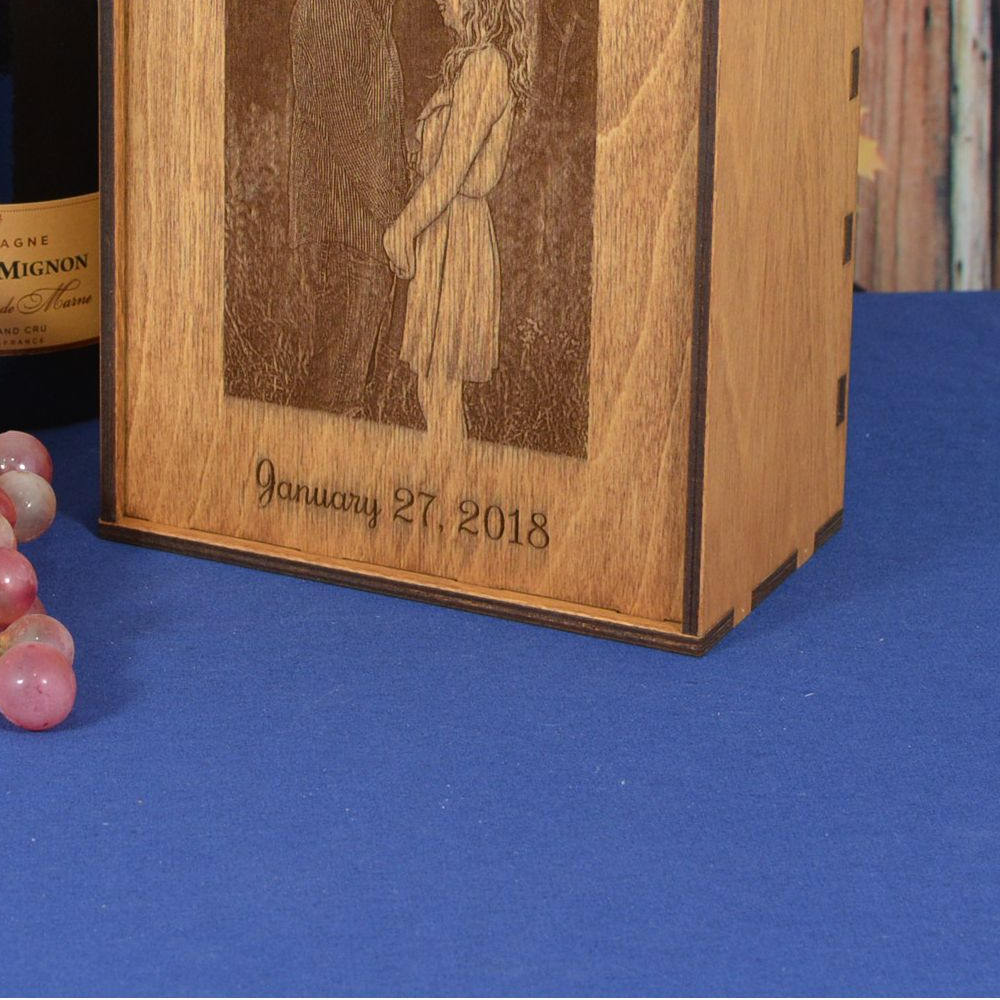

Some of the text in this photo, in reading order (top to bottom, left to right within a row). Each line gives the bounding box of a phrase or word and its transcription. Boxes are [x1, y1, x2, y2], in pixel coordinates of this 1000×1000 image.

[0, 296, 15, 314] de
[17, 279, 92, 315] Marne
[24, 324, 47, 334] CRU
[255, 458, 550, 549] January 27, 2018
